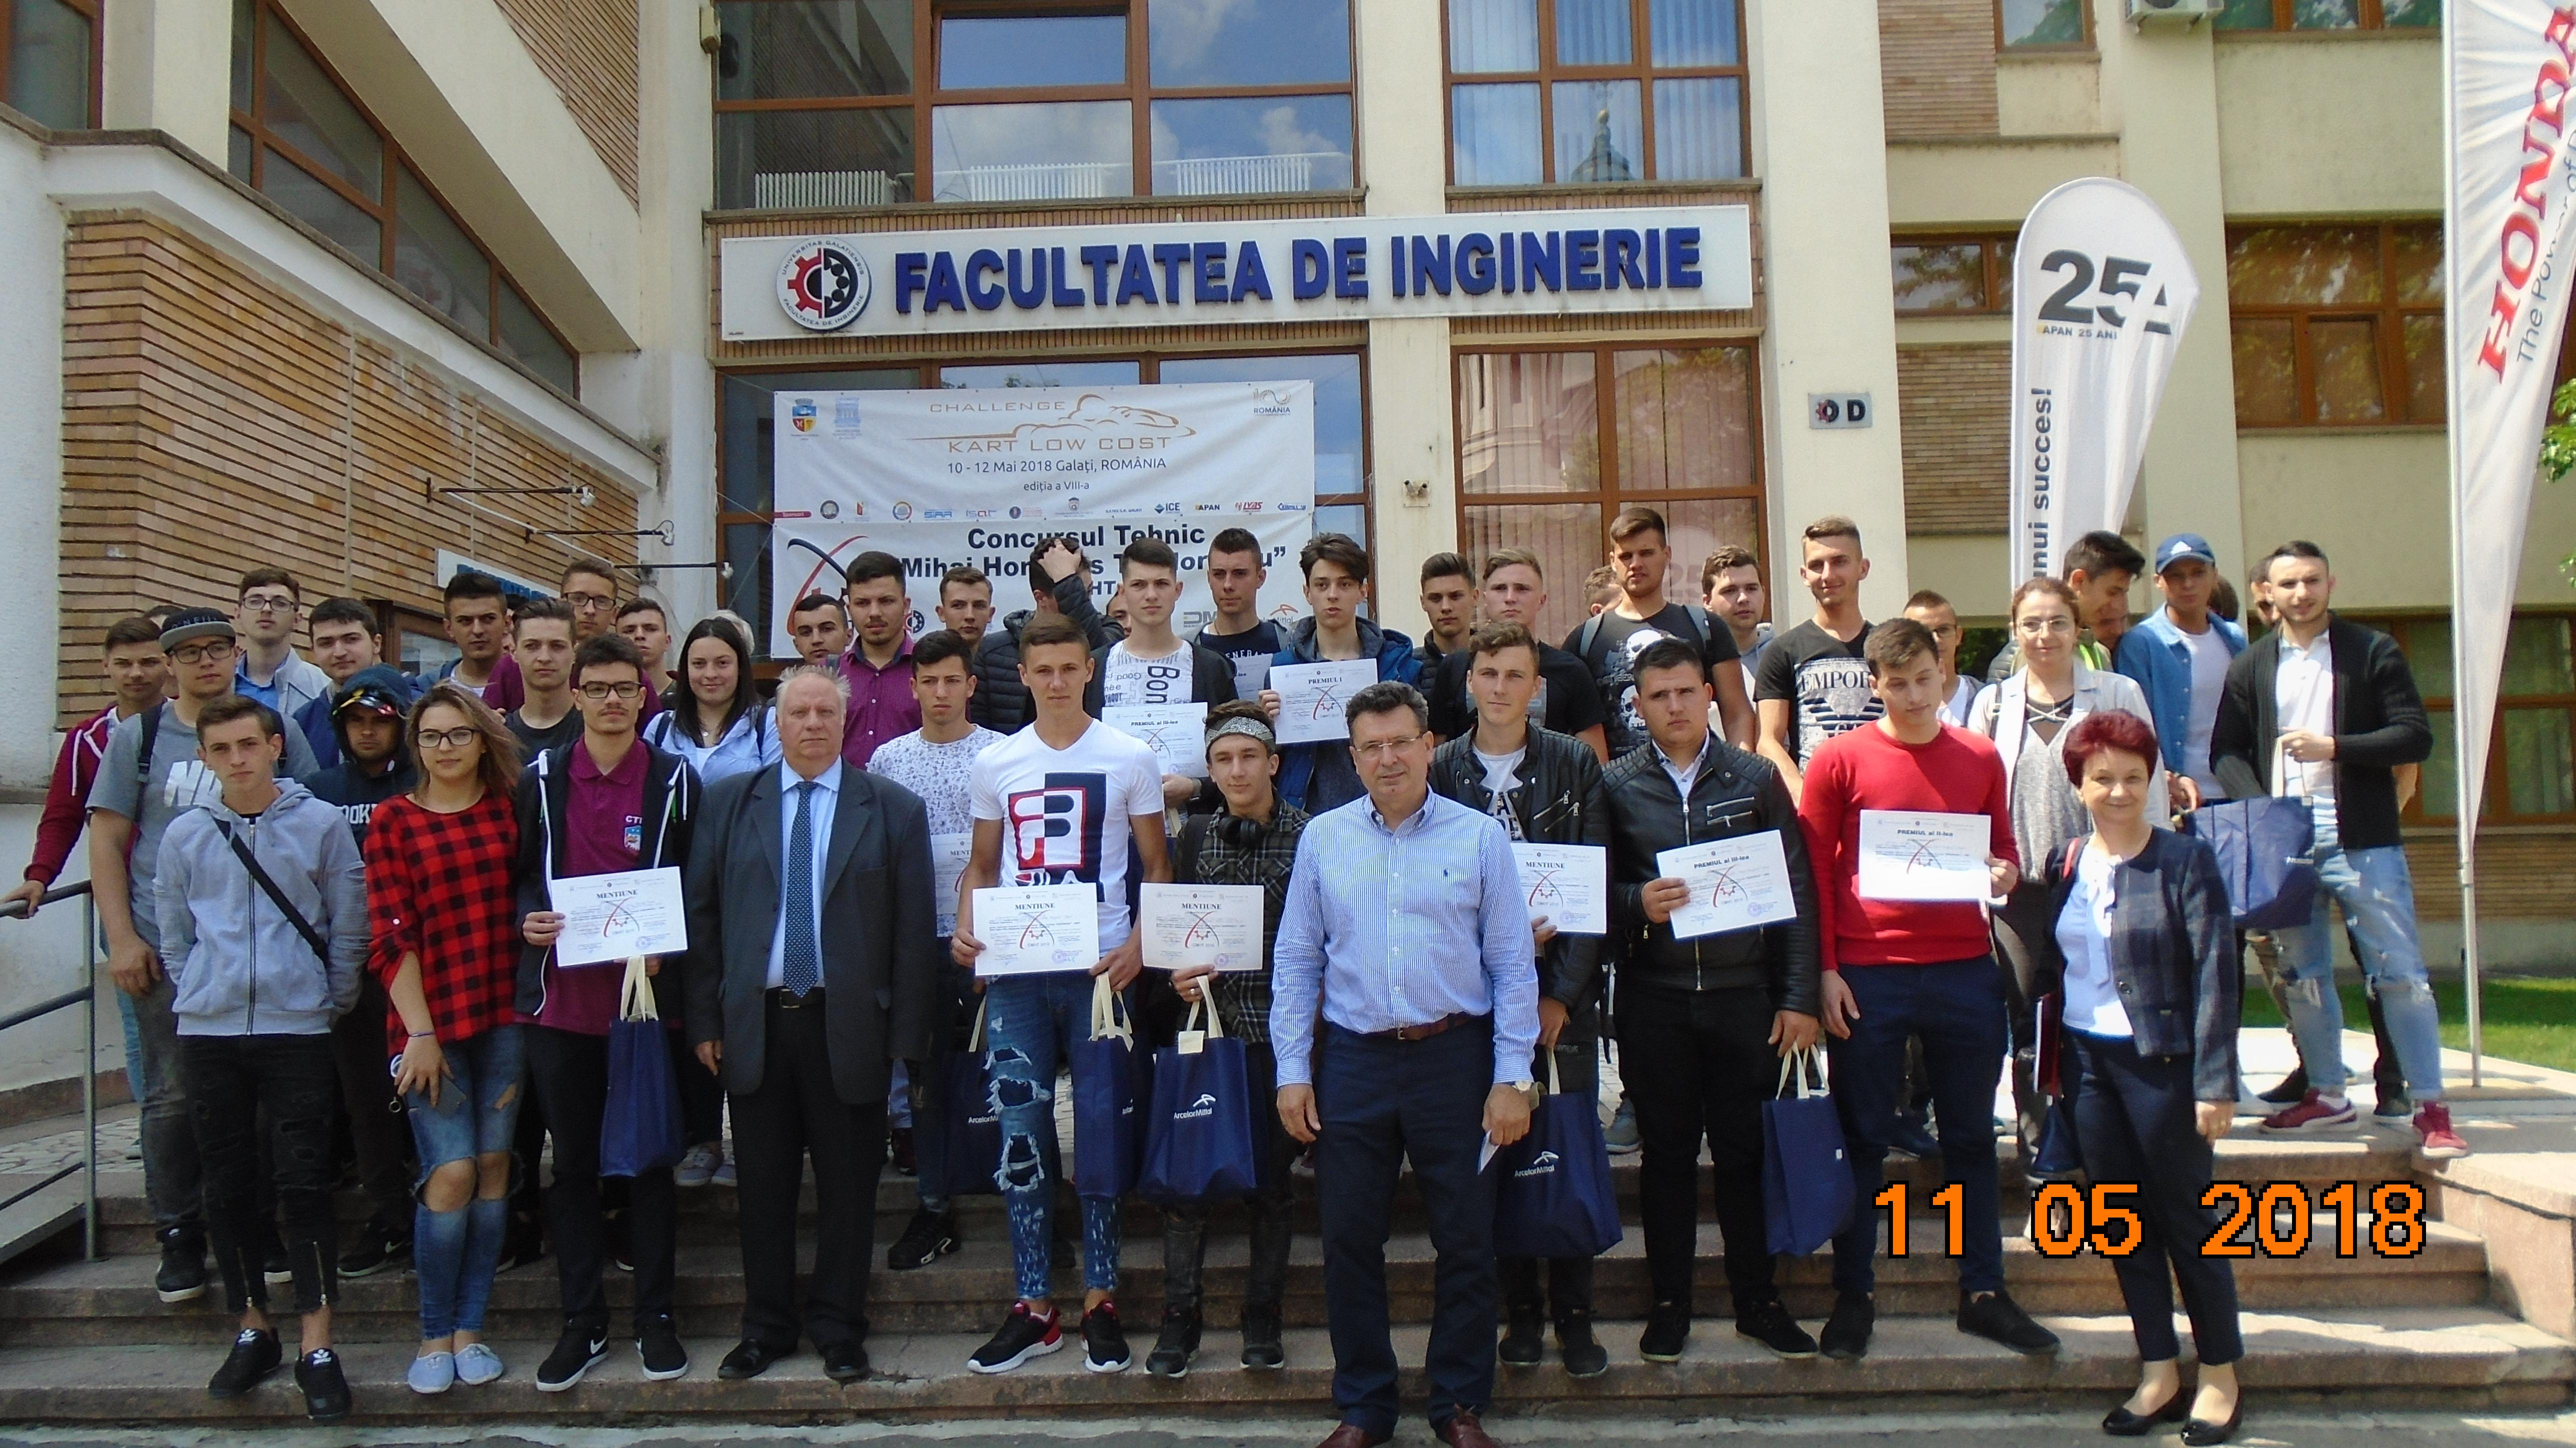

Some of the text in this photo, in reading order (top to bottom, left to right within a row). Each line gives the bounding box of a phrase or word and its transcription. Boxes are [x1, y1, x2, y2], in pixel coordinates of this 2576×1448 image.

[2478, 5, 2576, 384] HONDA
[782, 240, 822, 275] UNIVERSITAS
[895, 226, 1703, 314] FACULTATEA DE INGINERIE
[2038, 249, 2152, 328] 25
[784, 298, 820, 326] FACULTATEA
[2042, 325, 2118, 340] APAN 25 ANI
[2516, 308, 2544, 362] The
[930, 401, 1066, 413] CHALLENGE
[1254, 406, 1290, 414] ROMÂNIA
[949, 436, 1171, 453] KART LOW COST
[2030, 387, 2052, 510] succes!
[948, 462, 962, 474] 10
[975, 462, 990, 473] 12
[994, 460, 1018, 472] Mai
[1020, 460, 1052, 472] 2018
[1102, 456, 1166, 470] ROMÂNIA
[1064, 481, 1090, 490] VIII-a
[1165, 502, 1180, 512] ICE
[1114, 523, 1206, 546] Tehnic
[1694, 859, 1722, 868] PREMIUL
[1174, 1106, 1212, 1120] ArcelorMittal
[1514, 1164, 1555, 1177] ArcelorMittal
